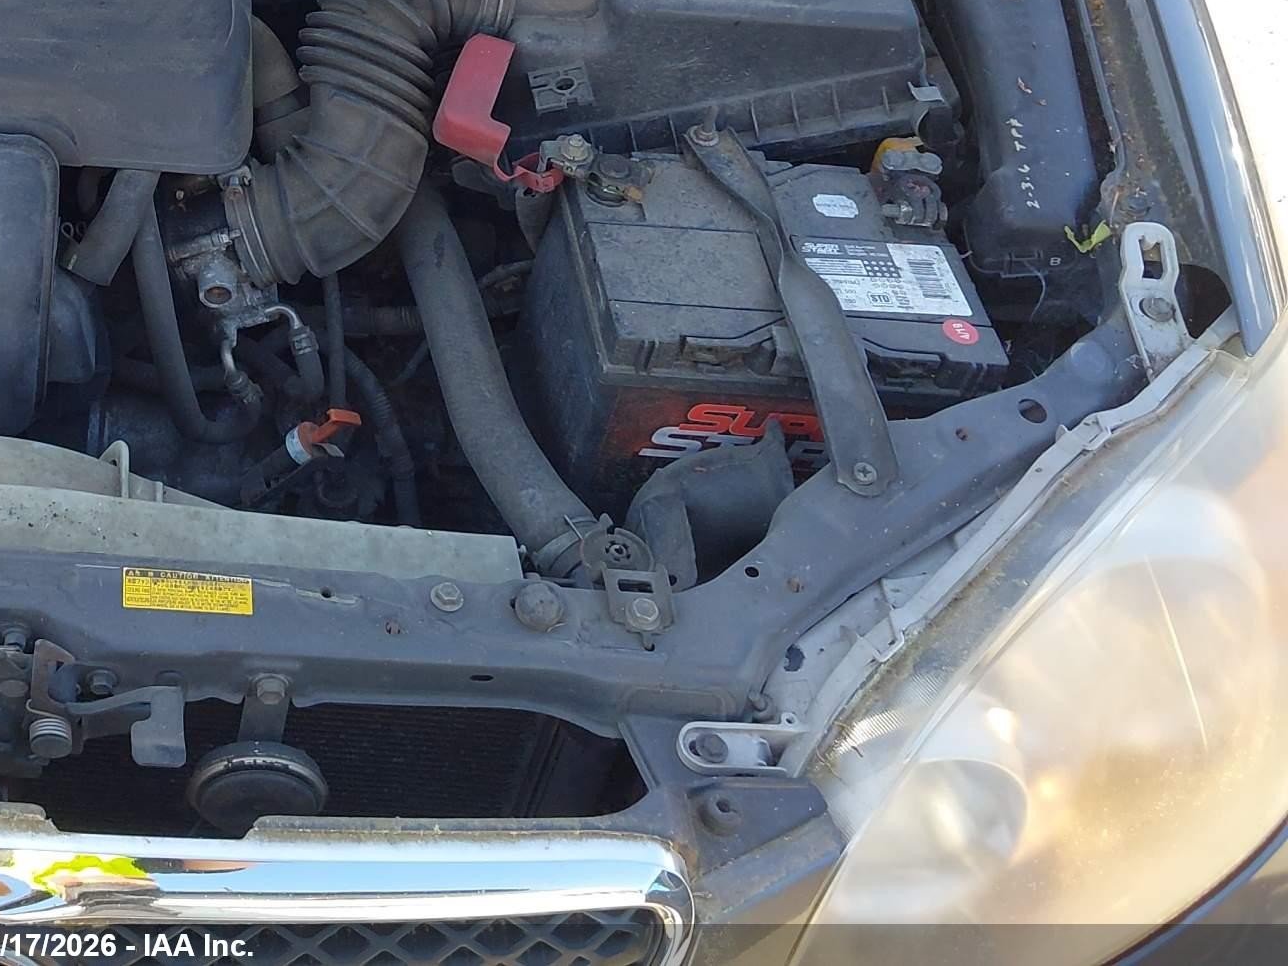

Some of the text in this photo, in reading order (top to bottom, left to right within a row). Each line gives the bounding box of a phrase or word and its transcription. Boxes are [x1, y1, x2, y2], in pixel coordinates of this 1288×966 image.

[870, 293, 891, 303] STD
[678, 403, 825, 441] SUP
[160, 571, 199, 579] CAUTION
